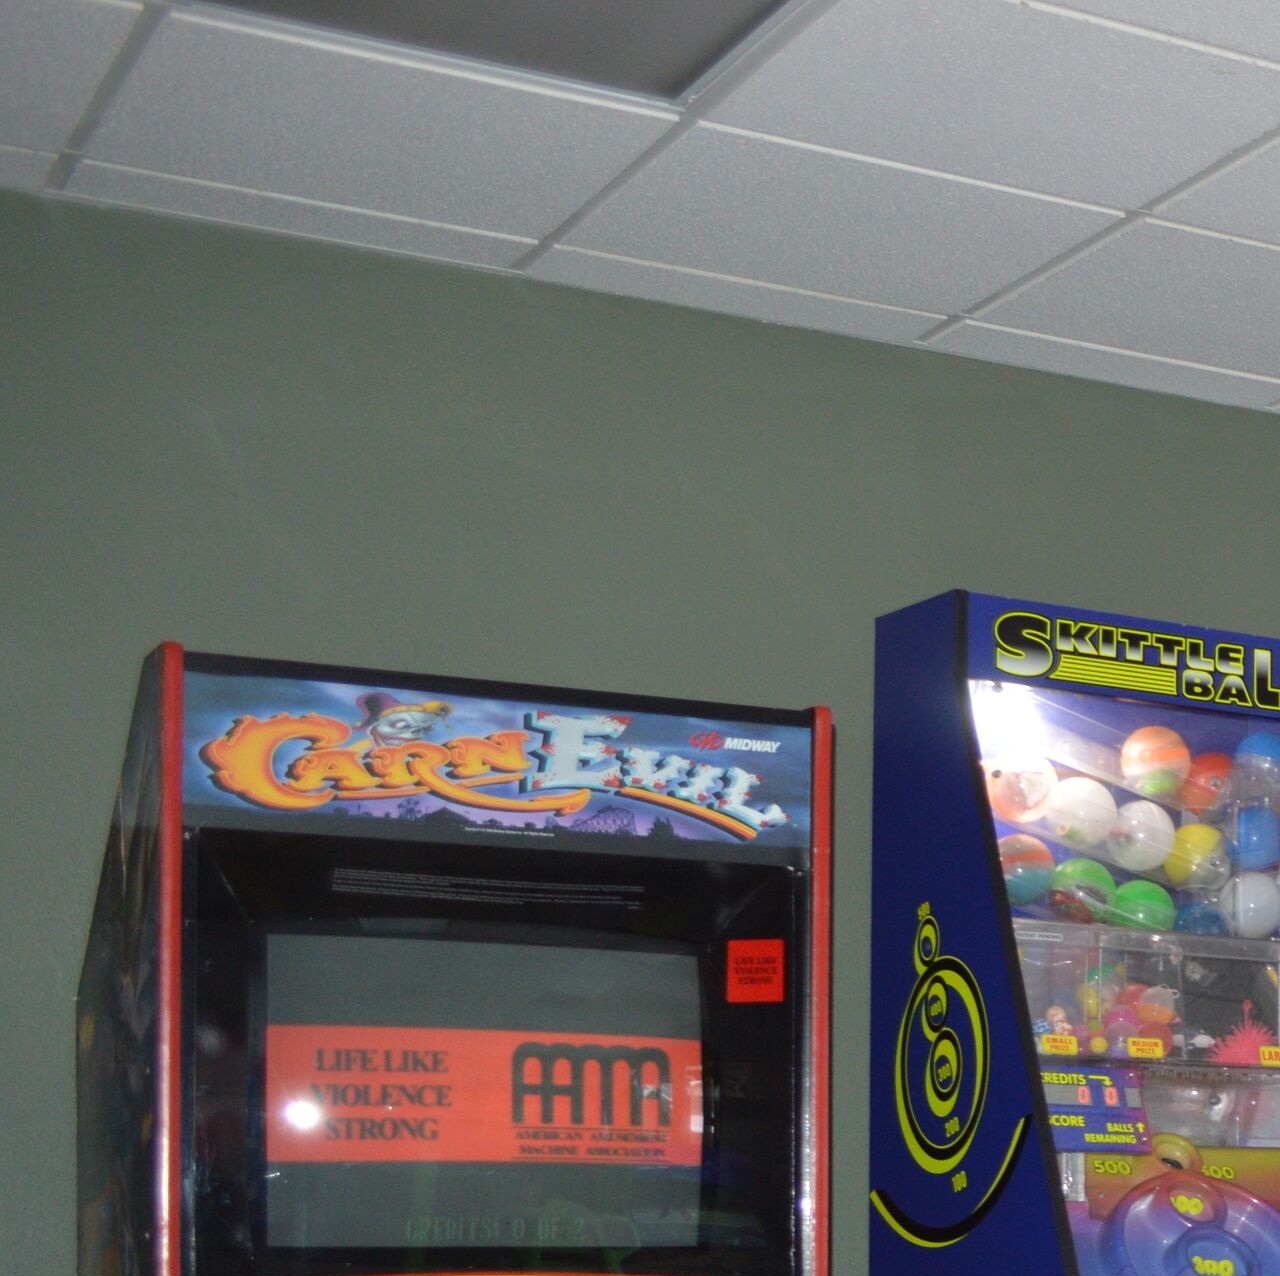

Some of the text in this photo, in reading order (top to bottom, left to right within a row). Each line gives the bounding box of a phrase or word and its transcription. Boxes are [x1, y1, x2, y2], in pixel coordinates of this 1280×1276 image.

[724, 737, 781, 754] MIDWAY
[1045, 1037, 1073, 1045] SMALL
[1050, 1044, 1071, 1052] PRIZE
[315, 1048, 449, 1074] LIFE LIKE
[312, 1082, 453, 1108] VIOLENCE
[325, 1117, 439, 1141] STRONG
[516, 1130, 583, 1141] AMERICAN
[944, 1116, 960, 1138] 200
[1106, 1122, 1135, 1133] BALLS
[1084, 1133, 1137, 1144] REMAINING
[520, 1144, 579, 1155] MACHINE
[1093, 1159, 1133, 1176] 500
[951, 1169, 969, 1194] 100
